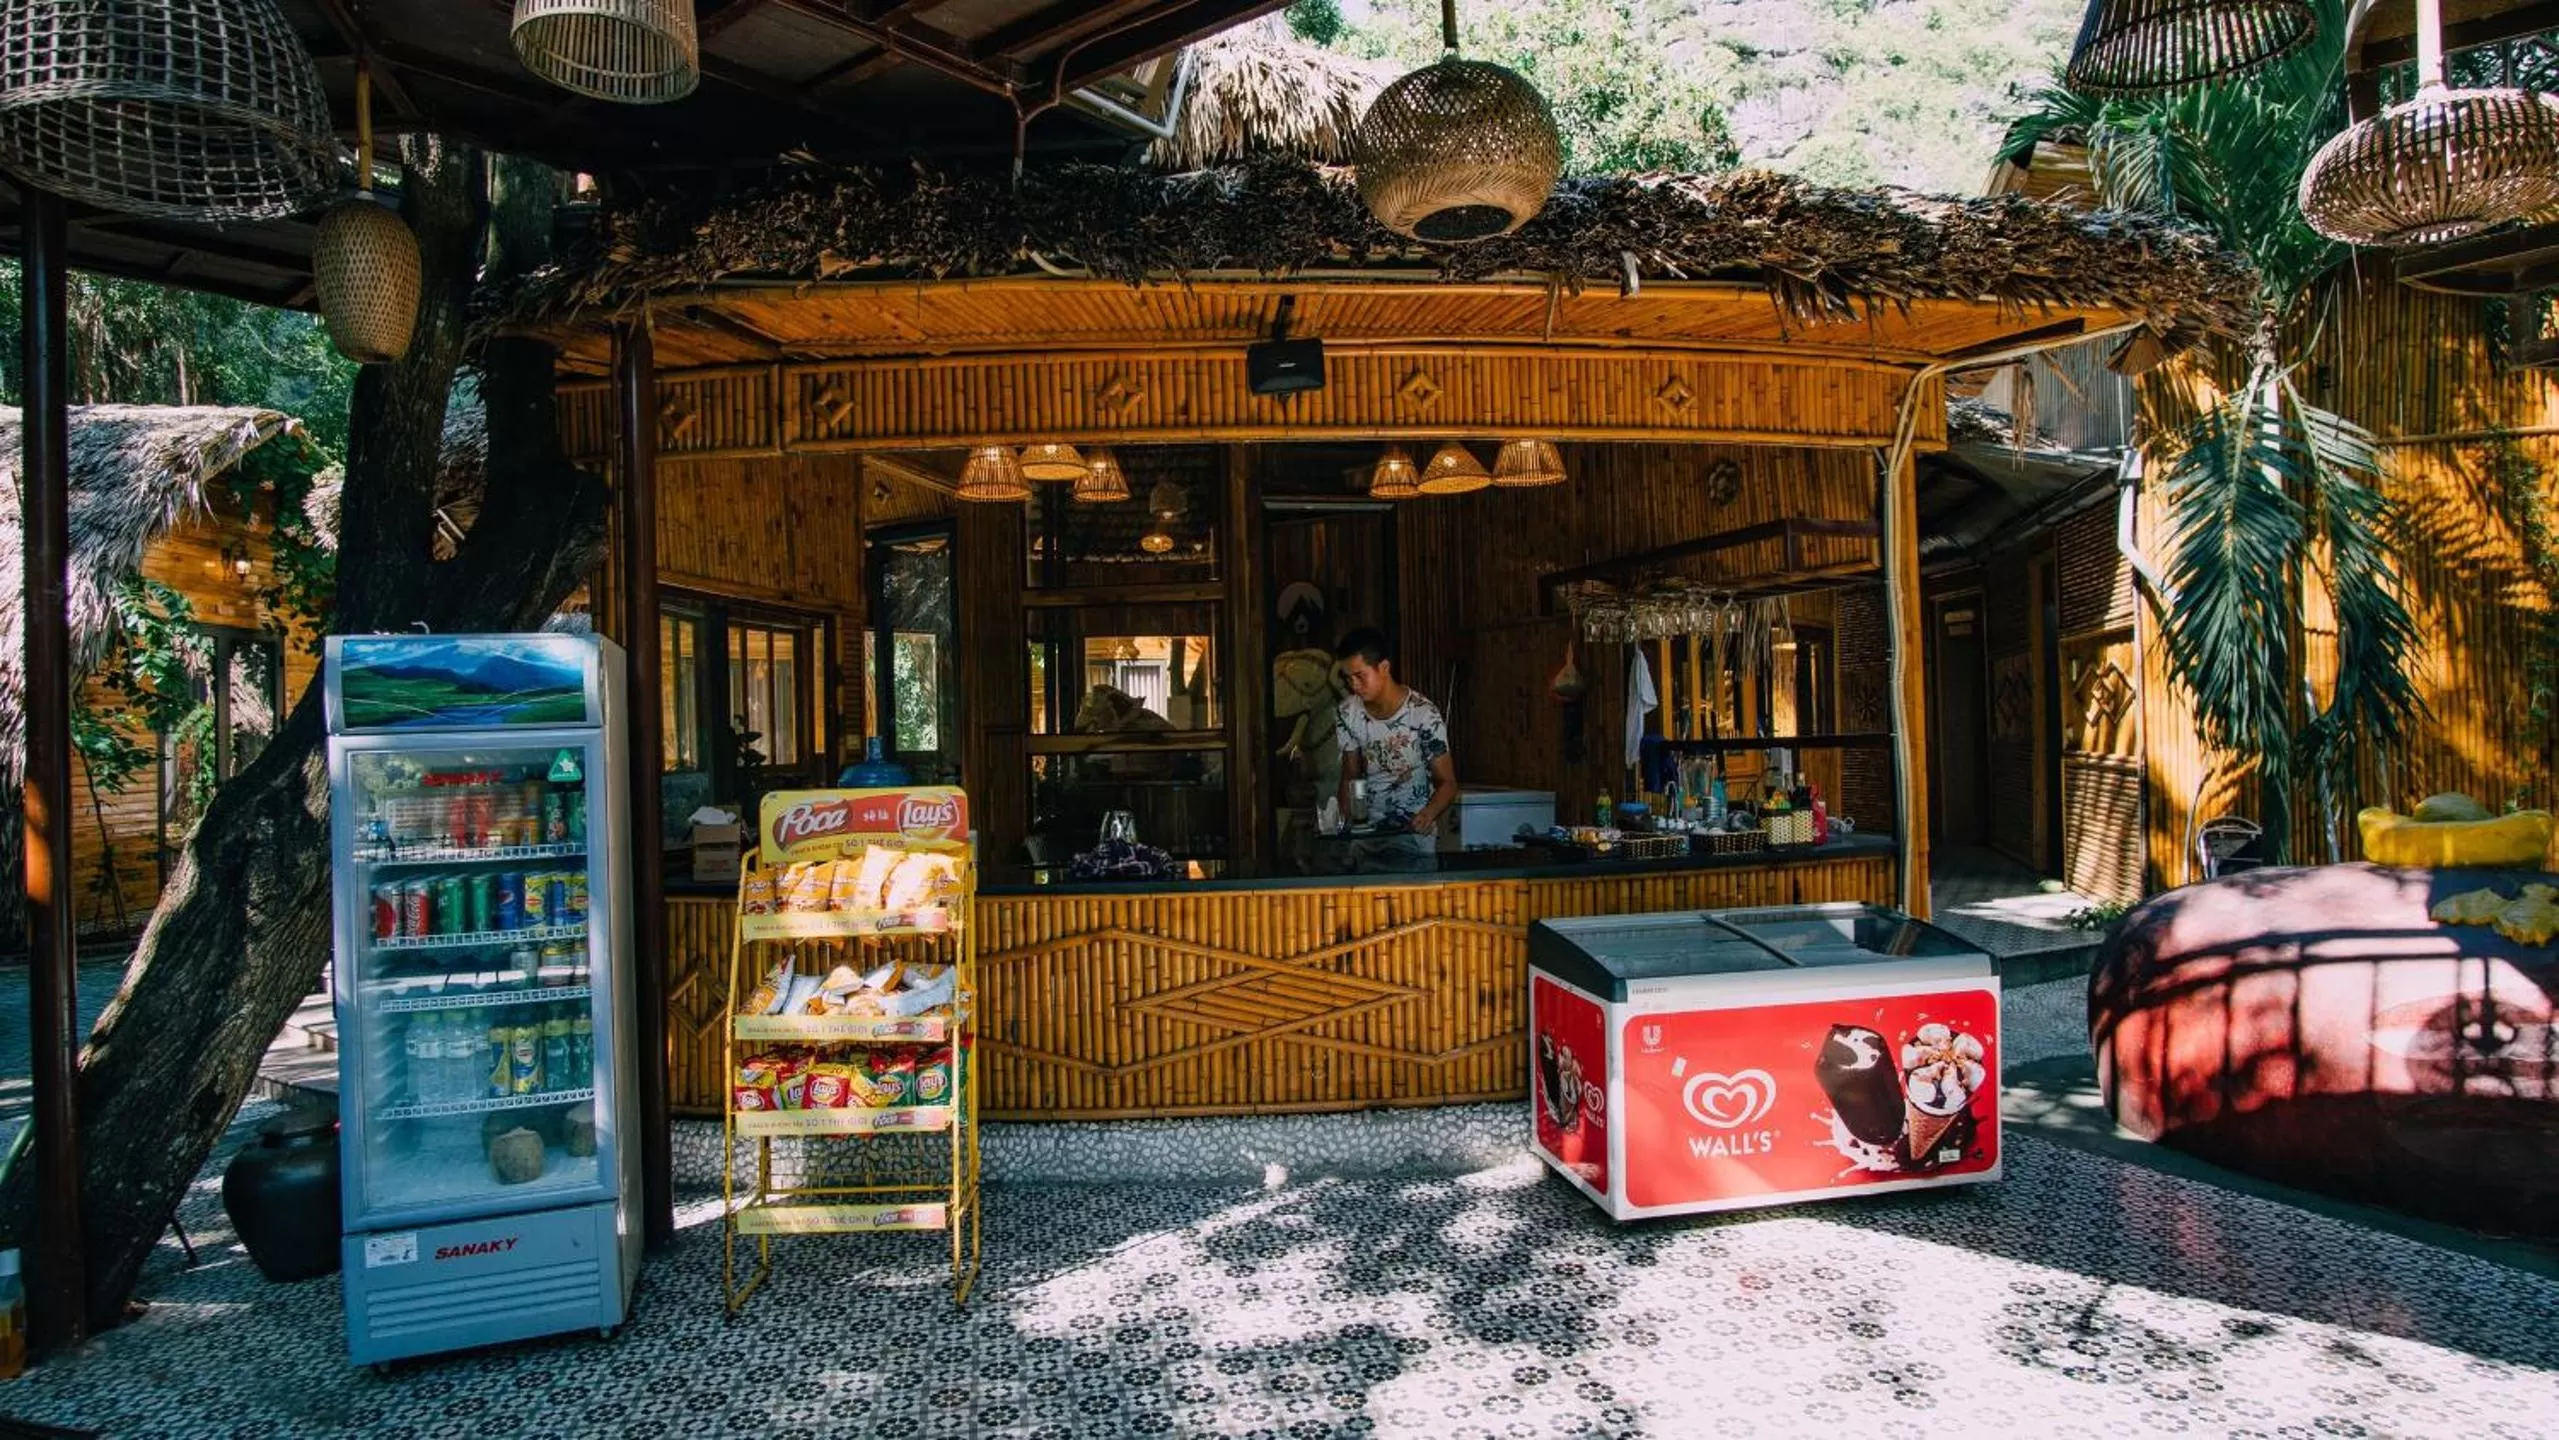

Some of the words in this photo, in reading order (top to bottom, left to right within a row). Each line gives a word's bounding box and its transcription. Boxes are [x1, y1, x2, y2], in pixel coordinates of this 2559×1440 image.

[780, 803, 848, 842] Poca
[1688, 1131, 1772, 1159] WALL'S
[435, 1237, 519, 1260] SANAKY
